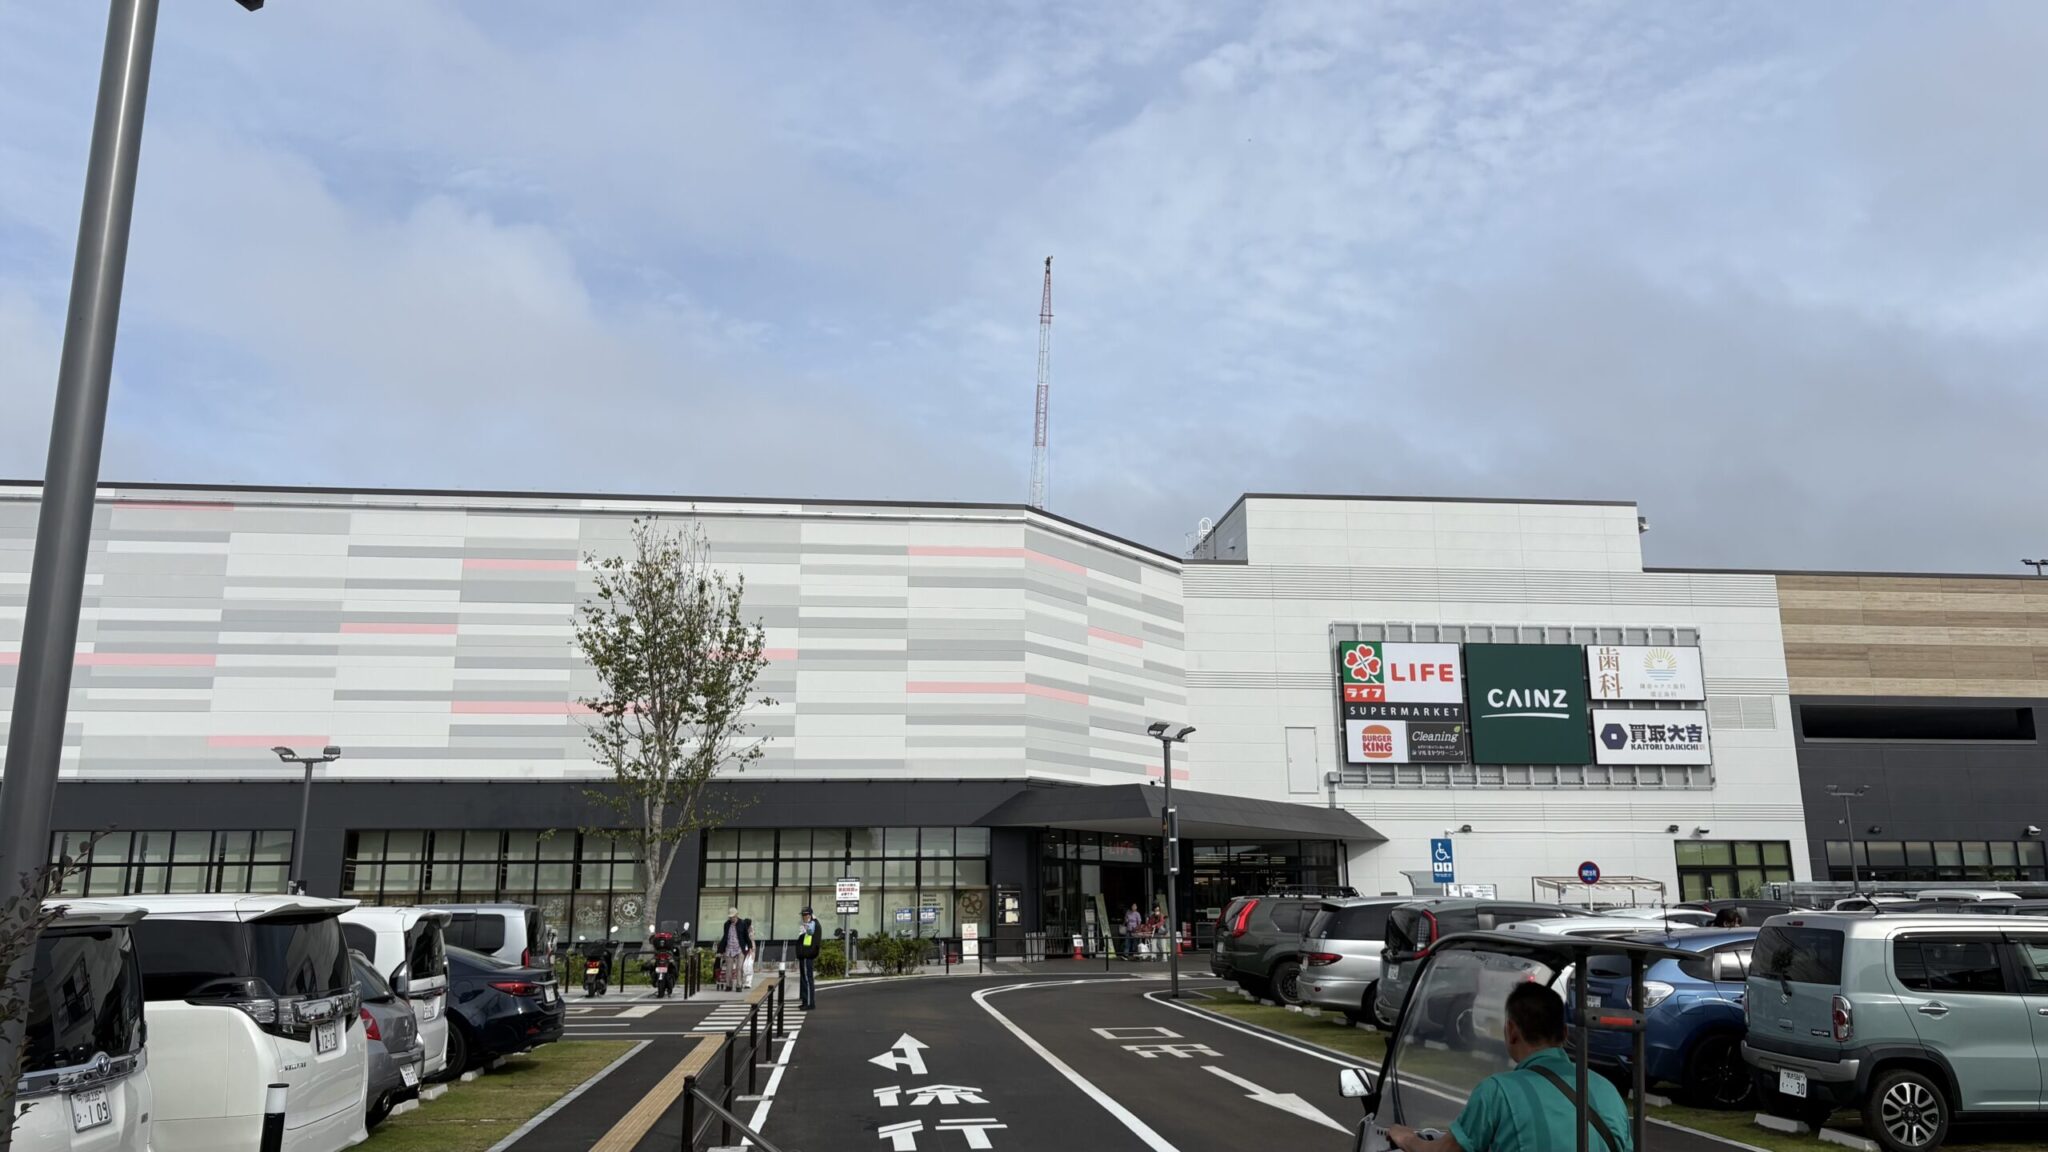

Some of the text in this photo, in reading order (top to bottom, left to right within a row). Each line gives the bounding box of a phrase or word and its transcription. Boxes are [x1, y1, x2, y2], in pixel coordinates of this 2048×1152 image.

[1390, 662, 1455, 682] LIFE
[1597, 647, 1623, 698] 歯科
[1346, 688, 1382, 698] ライフ
[1487, 688, 1568, 708] CAINZ
[1350, 706, 1459, 717] SUPERMARKET
[1412, 730, 1459, 743] Cleaning
[1628, 724, 1702, 743] 買取大吉
[1363, 742, 1392, 752] KING
